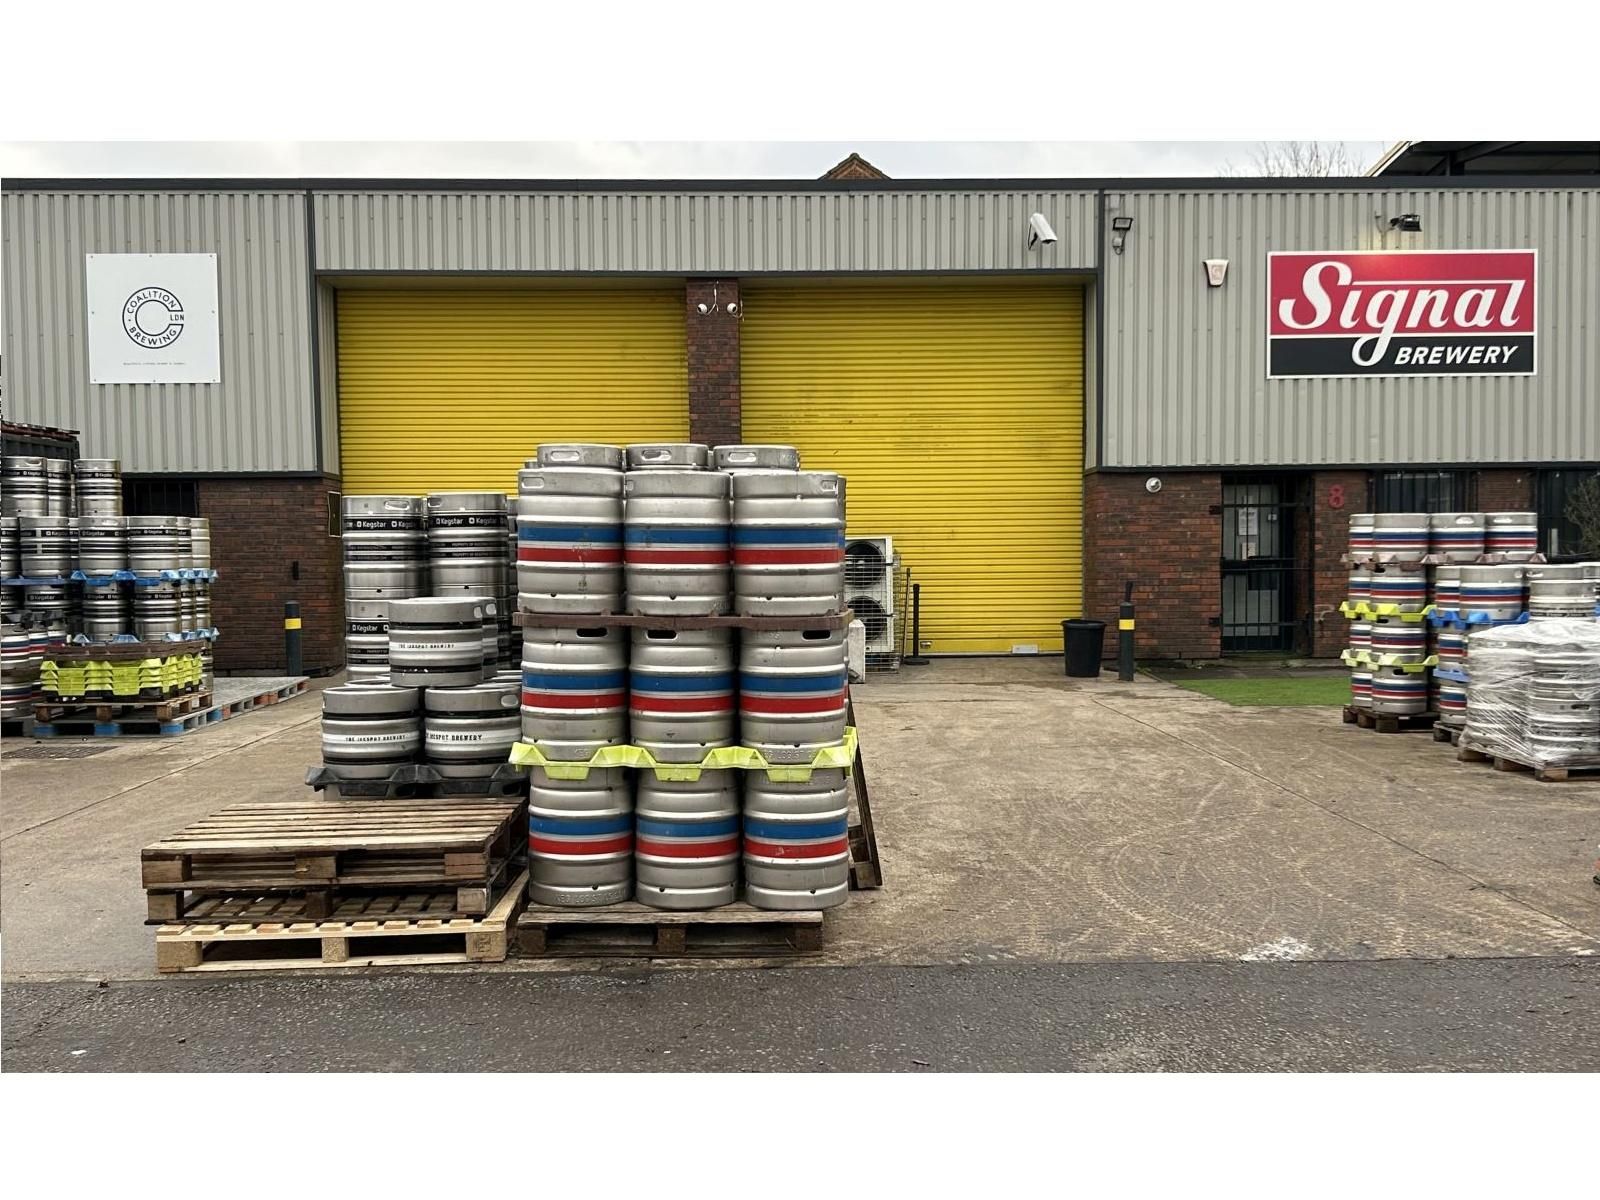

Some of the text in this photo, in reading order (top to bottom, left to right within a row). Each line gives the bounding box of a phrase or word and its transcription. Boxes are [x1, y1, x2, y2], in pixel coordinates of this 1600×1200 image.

[127, 290, 177, 314] COALITION
[1278, 260, 1526, 367] Signal
[129, 326, 177, 345] BREWING
[1394, 345, 1519, 365] BREWERY
[1328, 484, 1345, 509] 8
[362, 521, 387, 529] Kegstar
[441, 517, 464, 526] Kegstar
[356, 624, 378, 633] Kegstar
